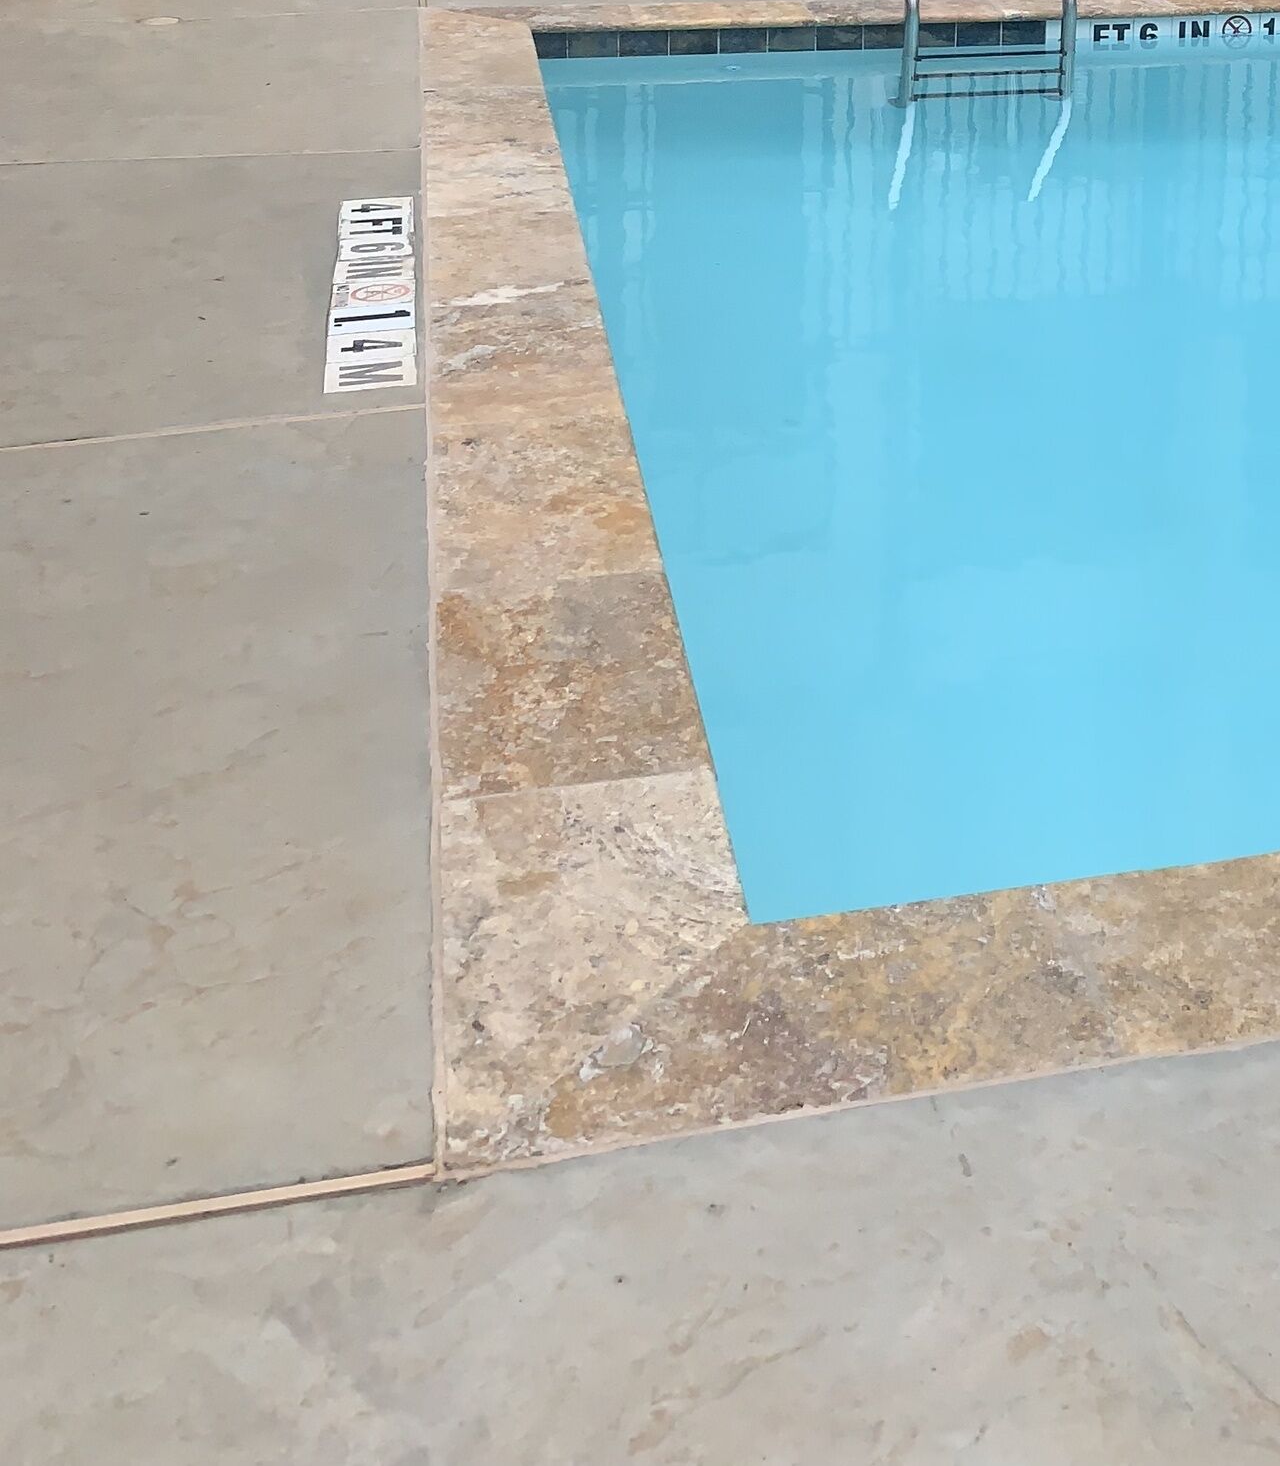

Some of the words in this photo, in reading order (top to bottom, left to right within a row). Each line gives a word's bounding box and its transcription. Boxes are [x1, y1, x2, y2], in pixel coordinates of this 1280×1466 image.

[1093, 23, 1130, 42] FT
[1178, 20, 1210, 39] IN
[338, 360, 404, 387] M
